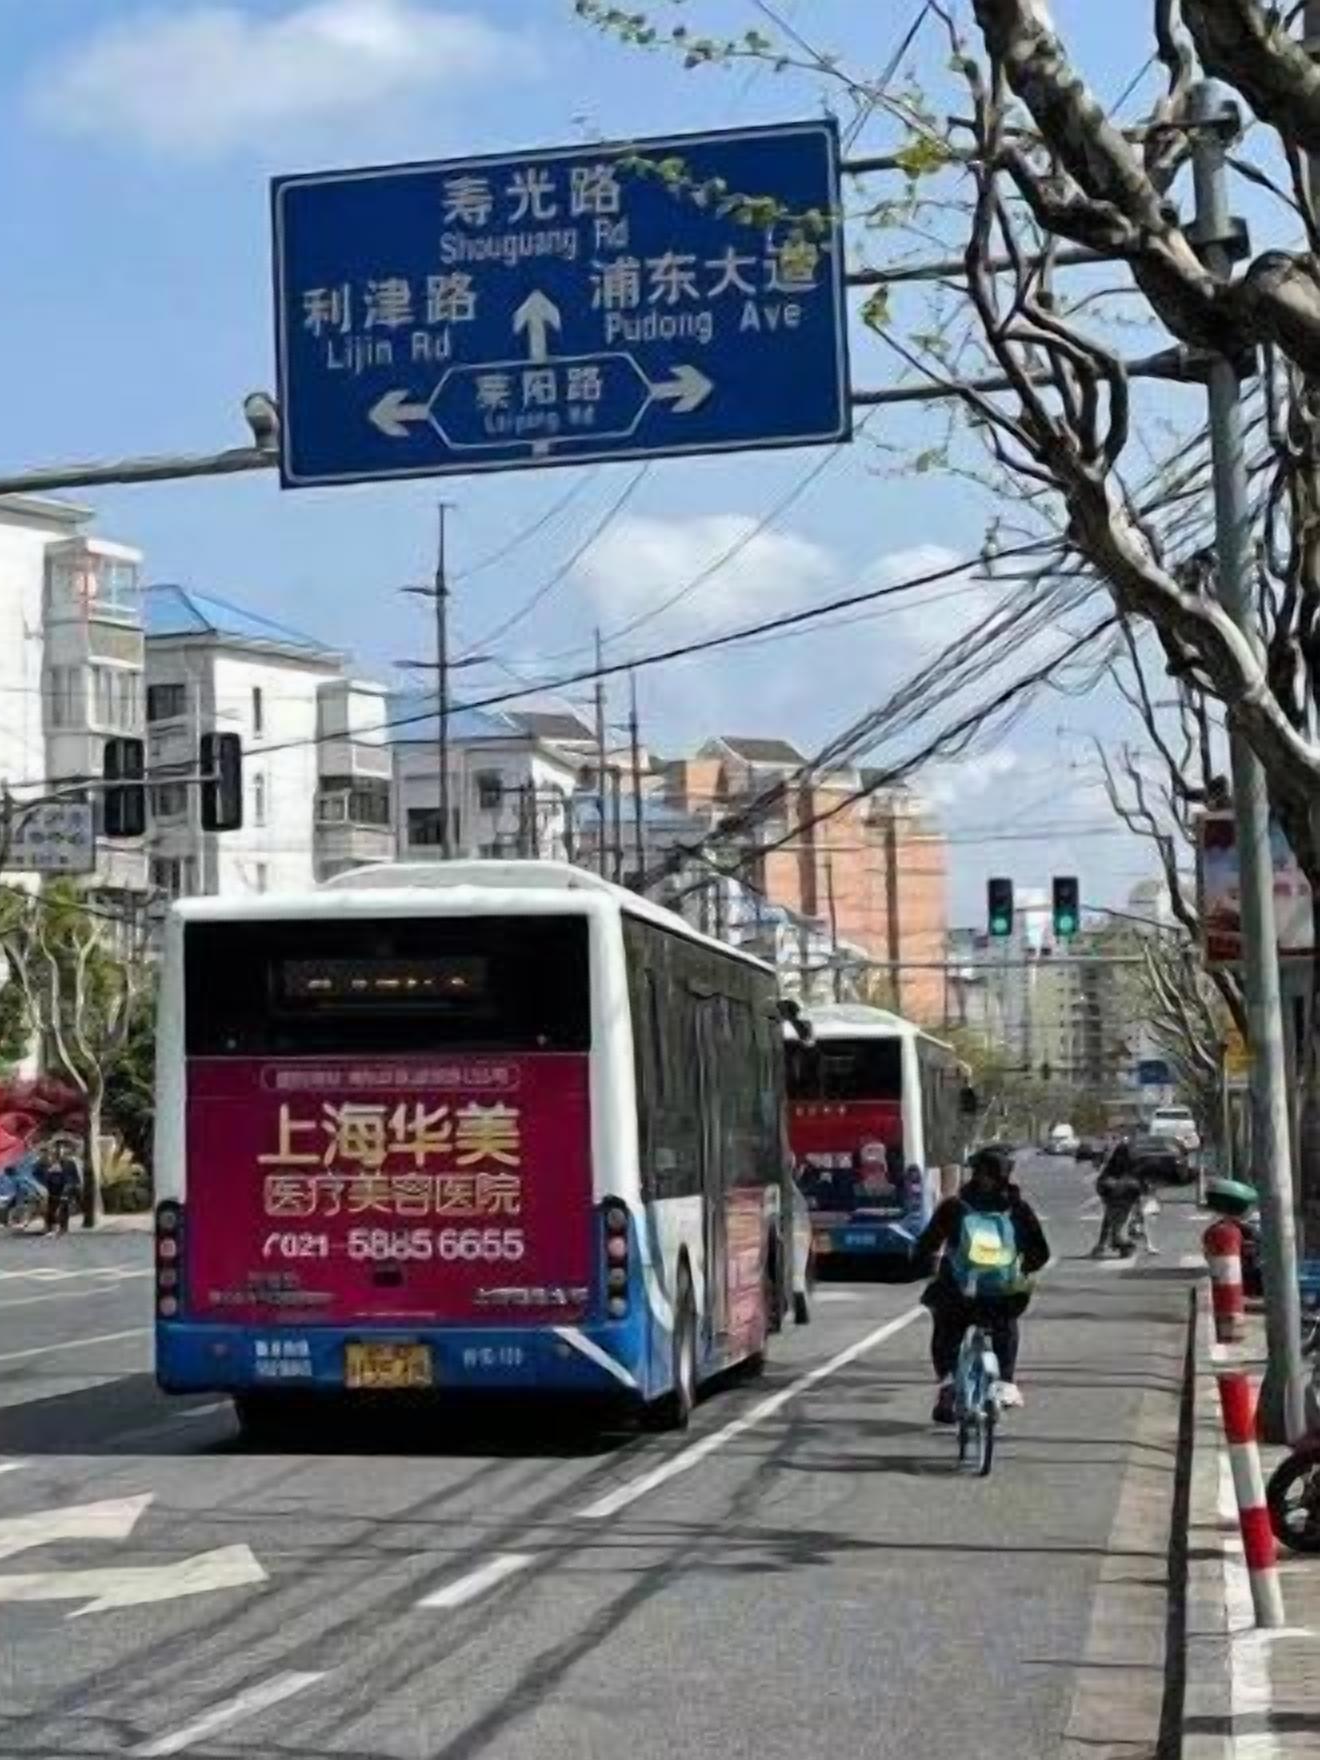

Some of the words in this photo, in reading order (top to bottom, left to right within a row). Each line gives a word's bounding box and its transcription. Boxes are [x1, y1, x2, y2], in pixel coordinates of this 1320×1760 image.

[443, 164, 622, 226] 寿光路
[440, 228, 578, 267] Shouguang
[594, 216, 629, 250] Rd
[303, 272, 477, 337] 利津路
[605, 306, 713, 345] Pudong
[739, 300, 802, 332] Ave
[328, 335, 393, 375] Lijin
[411, 325, 451, 362] Rd
[257, 1101, 521, 1167] 上海华美
[264, 1171, 521, 1217] 医疗美容医院
